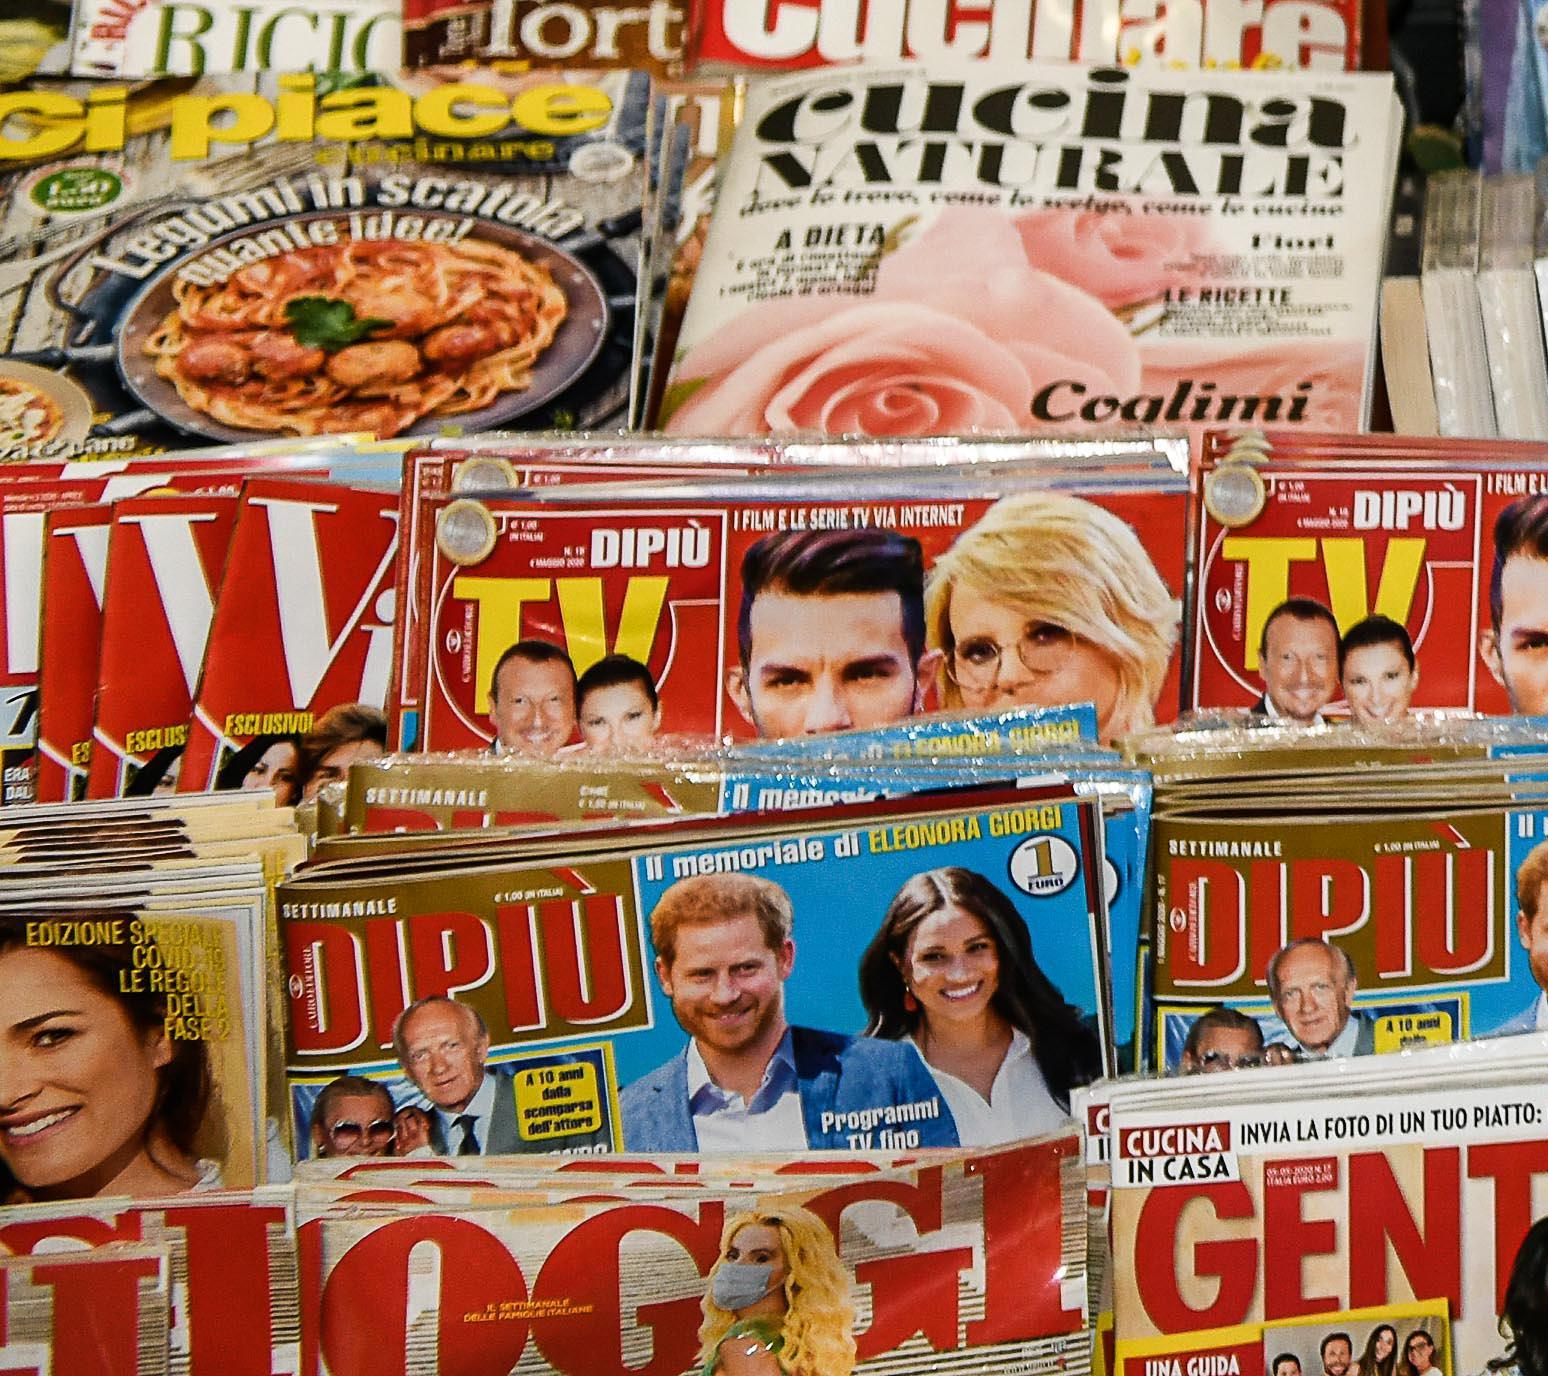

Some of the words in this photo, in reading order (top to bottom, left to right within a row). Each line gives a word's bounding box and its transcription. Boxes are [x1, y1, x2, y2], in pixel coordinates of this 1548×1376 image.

[171, 72, 613, 161] piace
[756, 67, 1359, 149] cucina
[755, 140, 1345, 198] NATURALE
[92, 179, 302, 280] Legumi
[309, 171, 364, 208] in
[377, 173, 588, 239] scatola
[1030, 378, 1311, 425] Coglimi
[1354, 482, 1466, 531] DIPIÙ
[591, 519, 711, 569] DIPIÙ
[646, 857, 663, 881] Il
[673, 837, 825, 876] memoriale
[834, 834, 860, 857] di
[868, 818, 980, 853] ELEONORA
[989, 806, 1062, 836] GIORGI
[282, 897, 397, 919] SETTIMANALE
[286, 866, 634, 1056] DIPIÙ
[1126, 1127, 1223, 1156] CUCINA
[1239, 1119, 1291, 1146] INVIA
[1297, 1117, 1319, 1141] LA
[1324, 1113, 1371, 1139] FOTO
[1376, 1110, 1394, 1135] DI
[1400, 1109, 1426, 1134] UN
[1431, 1107, 1468, 1131] TUO
[1472, 1104, 1542, 1129] PIATTO:
[1128, 1158, 1156, 1184] IN
[1164, 1154, 1230, 1182] CASA
